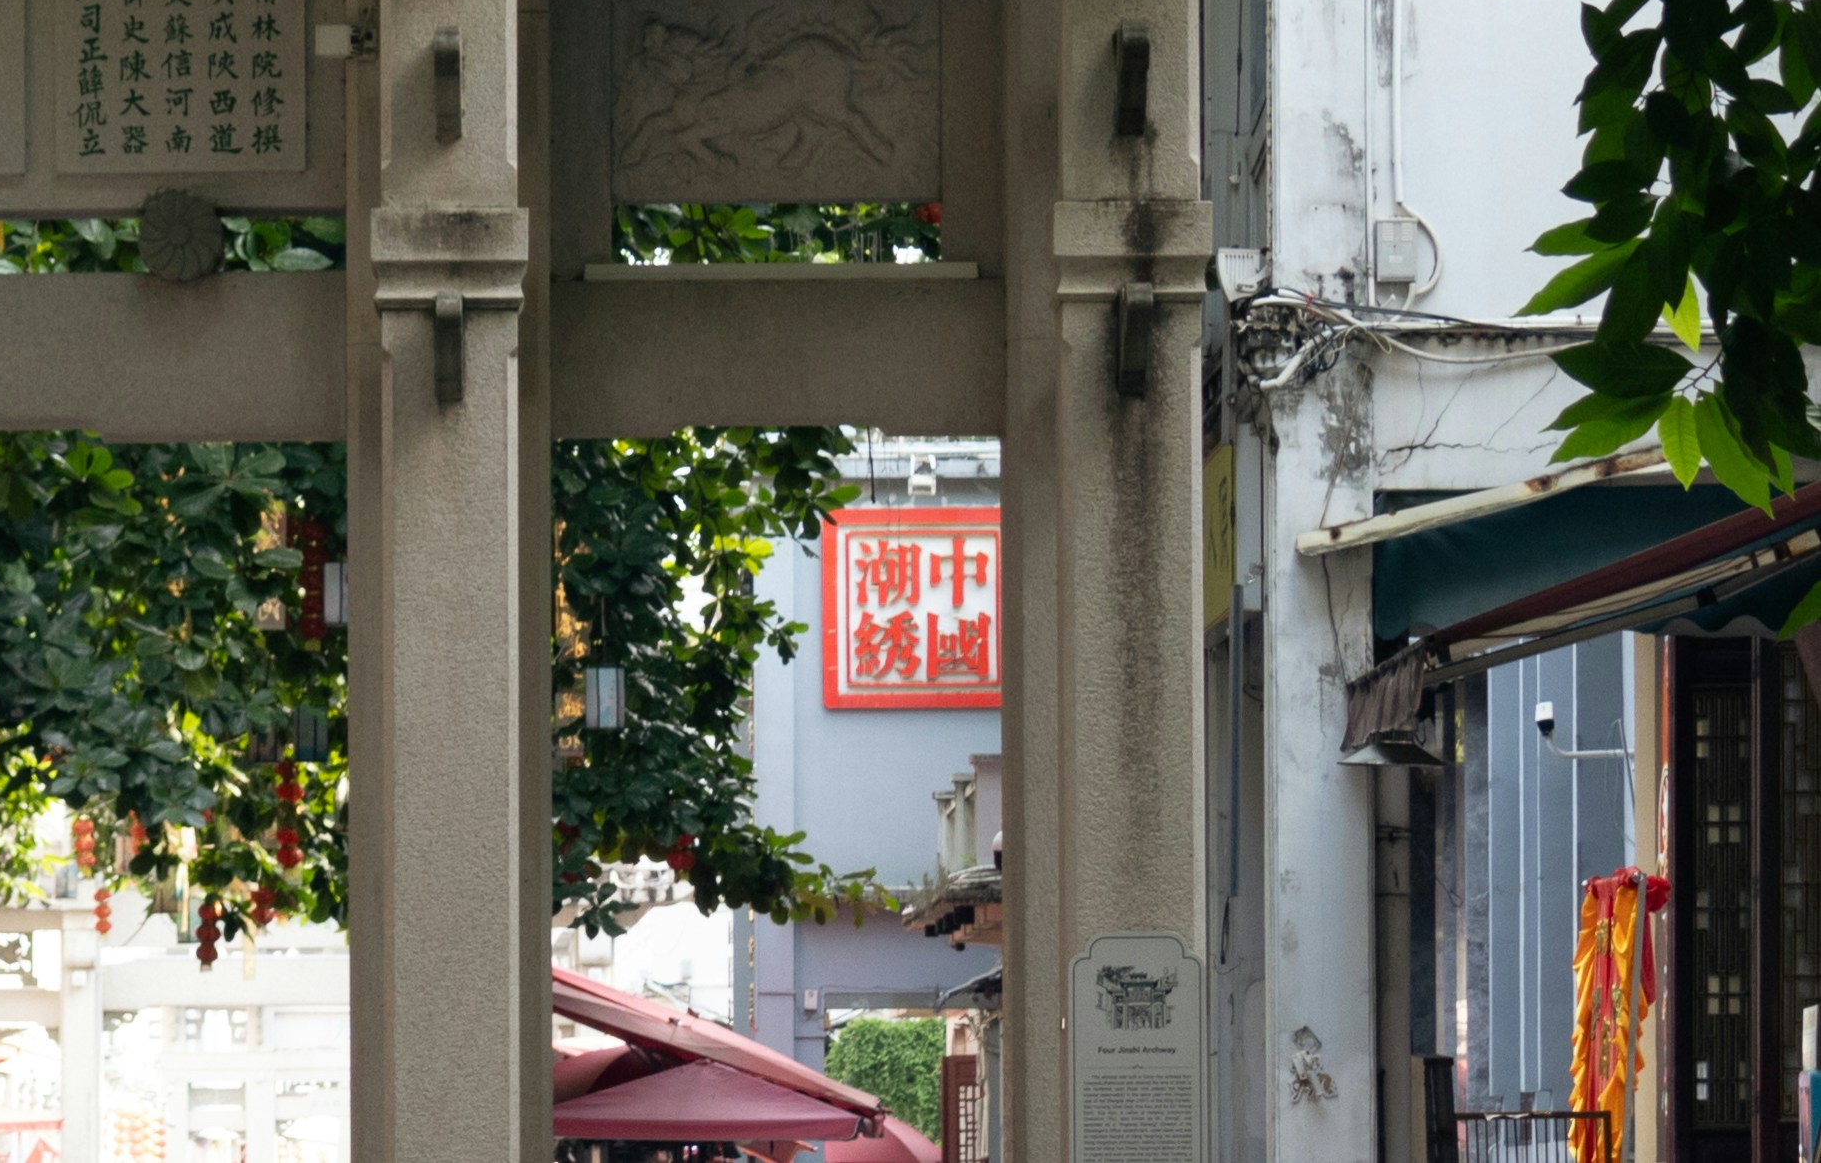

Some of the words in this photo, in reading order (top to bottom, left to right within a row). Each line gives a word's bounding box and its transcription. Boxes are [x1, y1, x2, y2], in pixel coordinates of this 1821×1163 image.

[1097, 1046, 1116, 1054] Four
[1118, 1046, 1141, 1054] Jinshi
[1142, 1046, 1177, 1055] Archway
